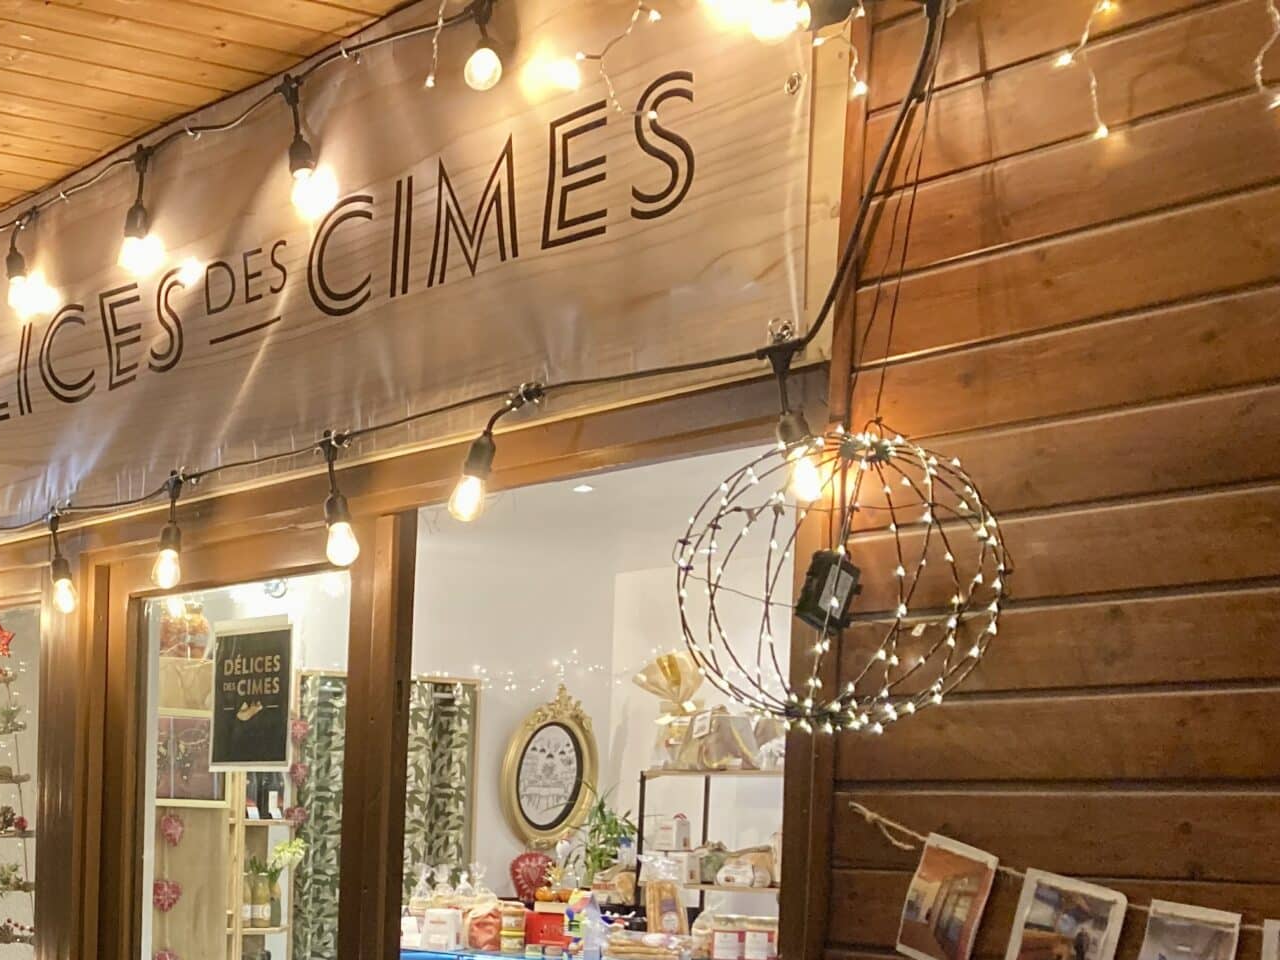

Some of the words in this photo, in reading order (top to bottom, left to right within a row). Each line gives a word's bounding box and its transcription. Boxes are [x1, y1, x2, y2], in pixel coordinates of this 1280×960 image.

[205, 239, 288, 317] DES
[308, 70, 695, 318] CIMES
[223, 654, 280, 676] DÉLICES
[237, 676, 280, 697] CIMES
